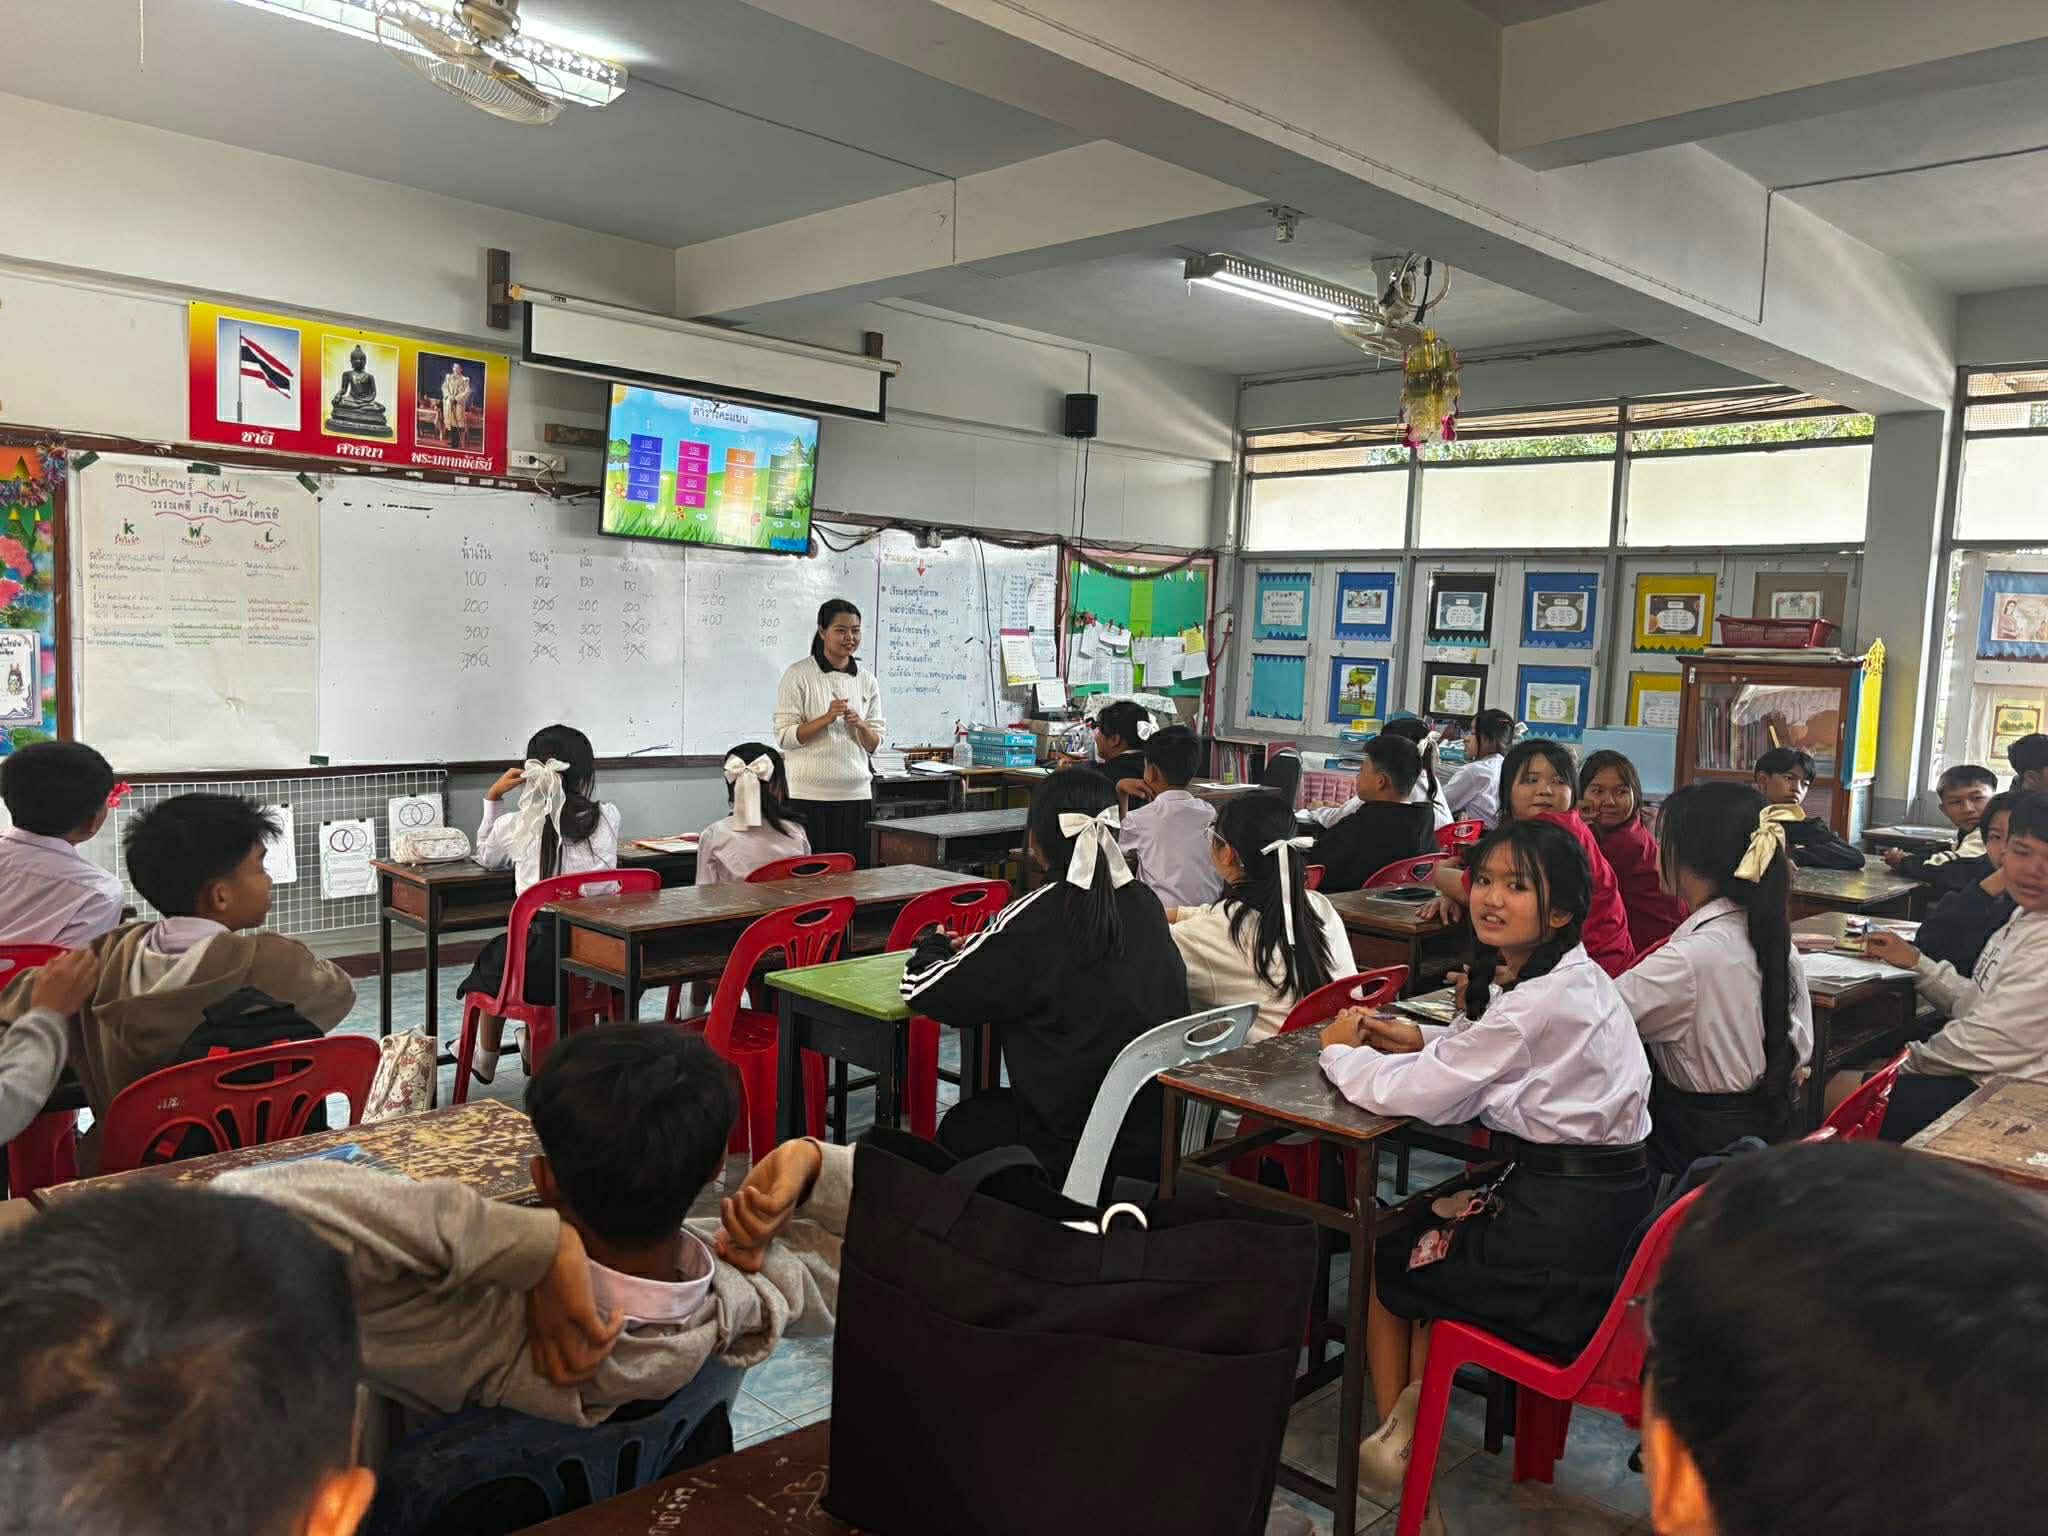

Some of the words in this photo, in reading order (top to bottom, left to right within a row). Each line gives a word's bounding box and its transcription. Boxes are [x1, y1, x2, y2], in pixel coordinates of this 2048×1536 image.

[240, 430, 273, 446] ชาติ
[336, 443, 384, 459] ศาสนา
[411, 452, 493, 471] พระมหากษัตริย์
[464, 570, 487, 587] 100
[463, 598, 489, 614] 200
[464, 624, 490, 641] 300
